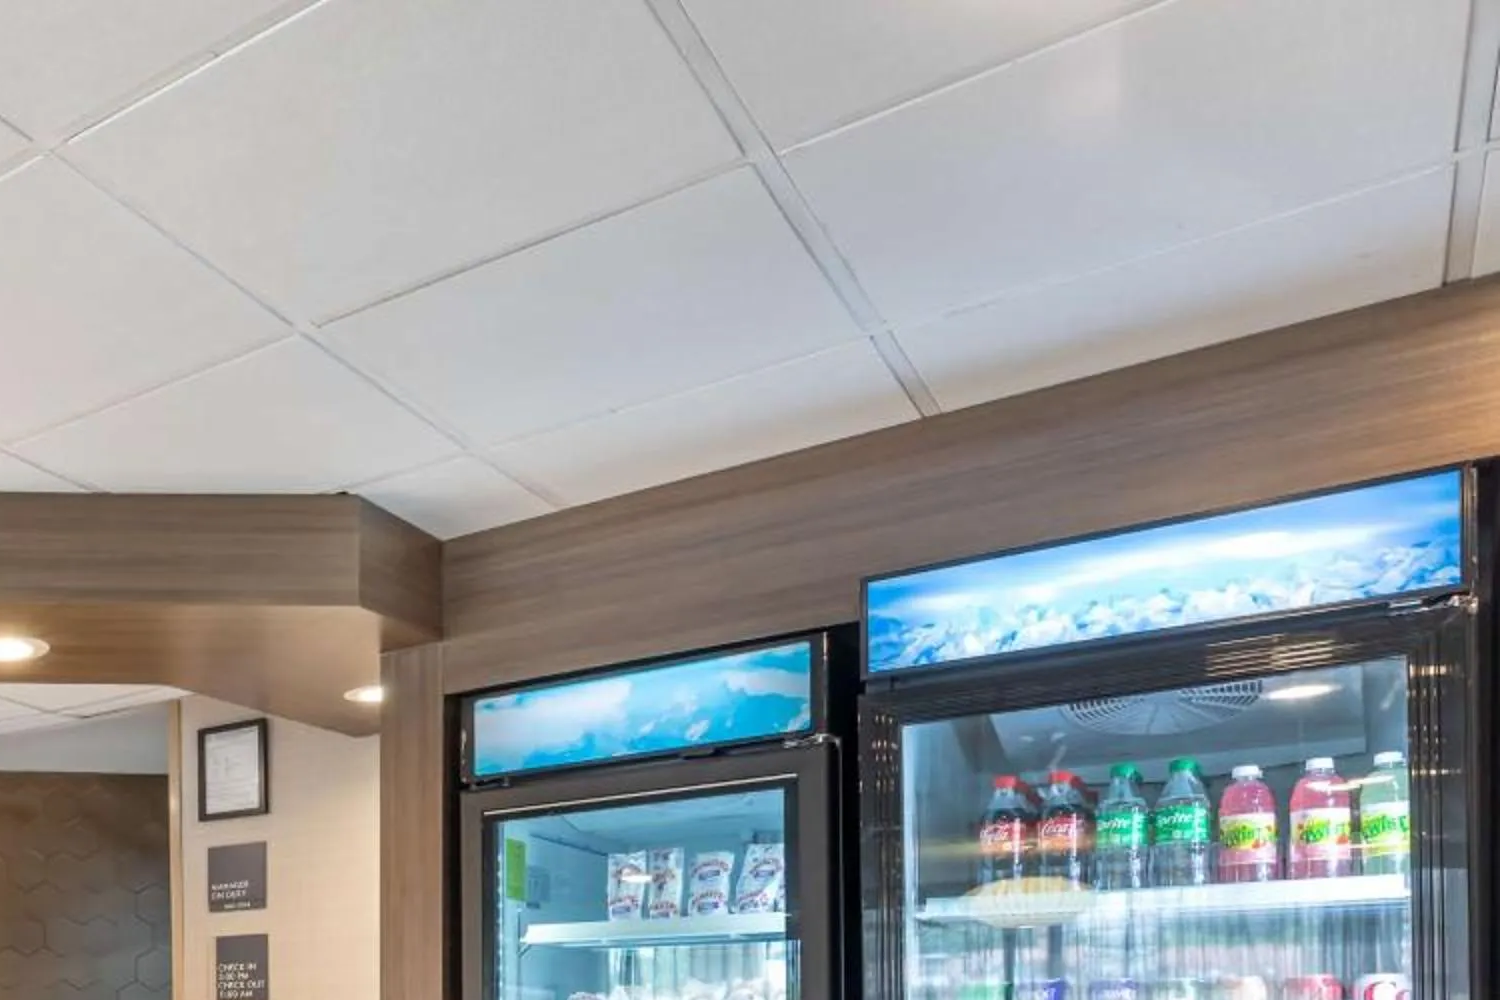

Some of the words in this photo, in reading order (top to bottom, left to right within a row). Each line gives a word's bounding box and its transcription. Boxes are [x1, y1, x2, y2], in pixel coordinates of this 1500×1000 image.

[218, 963, 245, 971] CHECK
[218, 980, 245, 989] CHECK
[247, 979, 265, 989] OUT
